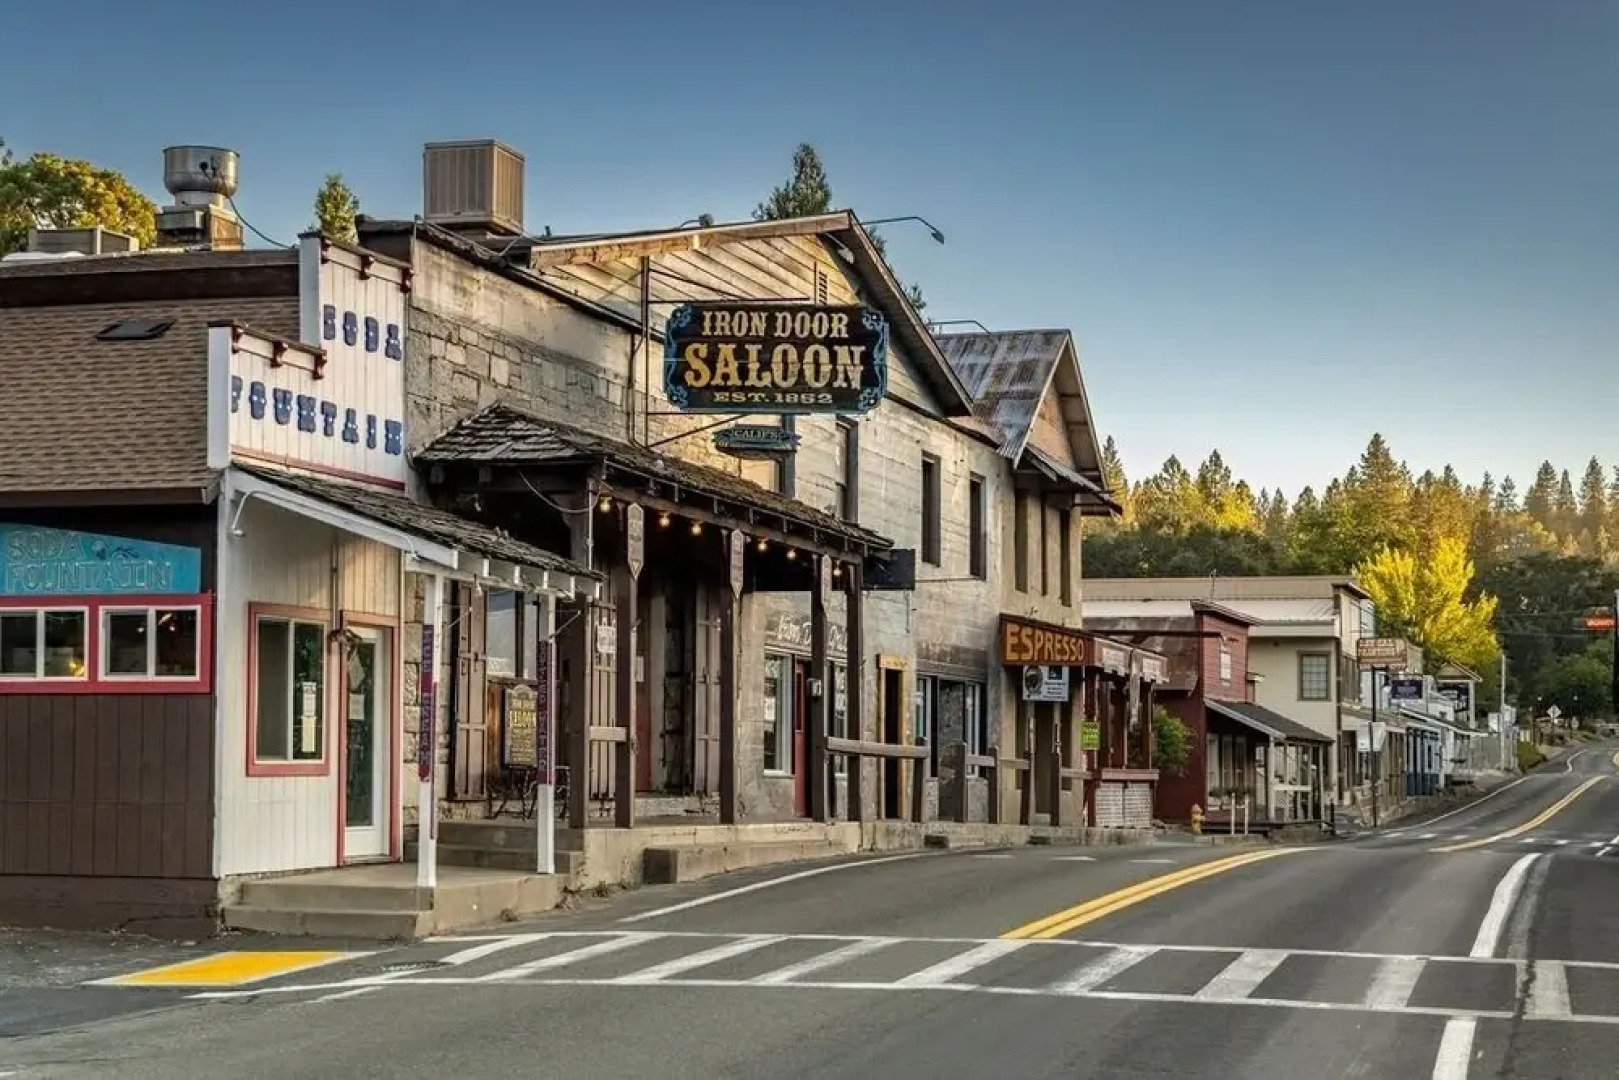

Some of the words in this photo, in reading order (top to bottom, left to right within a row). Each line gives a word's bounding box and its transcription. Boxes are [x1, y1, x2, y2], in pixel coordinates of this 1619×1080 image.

[323, 304, 402, 361] SODA
[701, 310, 768, 336] IRON
[774, 311, 849, 338] DOOR
[684, 342, 866, 389] SALOON
[713, 391, 769, 404] EST.
[774, 392, 833, 404] 1852
[8, 529, 80, 559] SODA
[7, 561, 172, 590] FOUNTAIN
[1006, 622, 1085, 662] ESPRESSO
